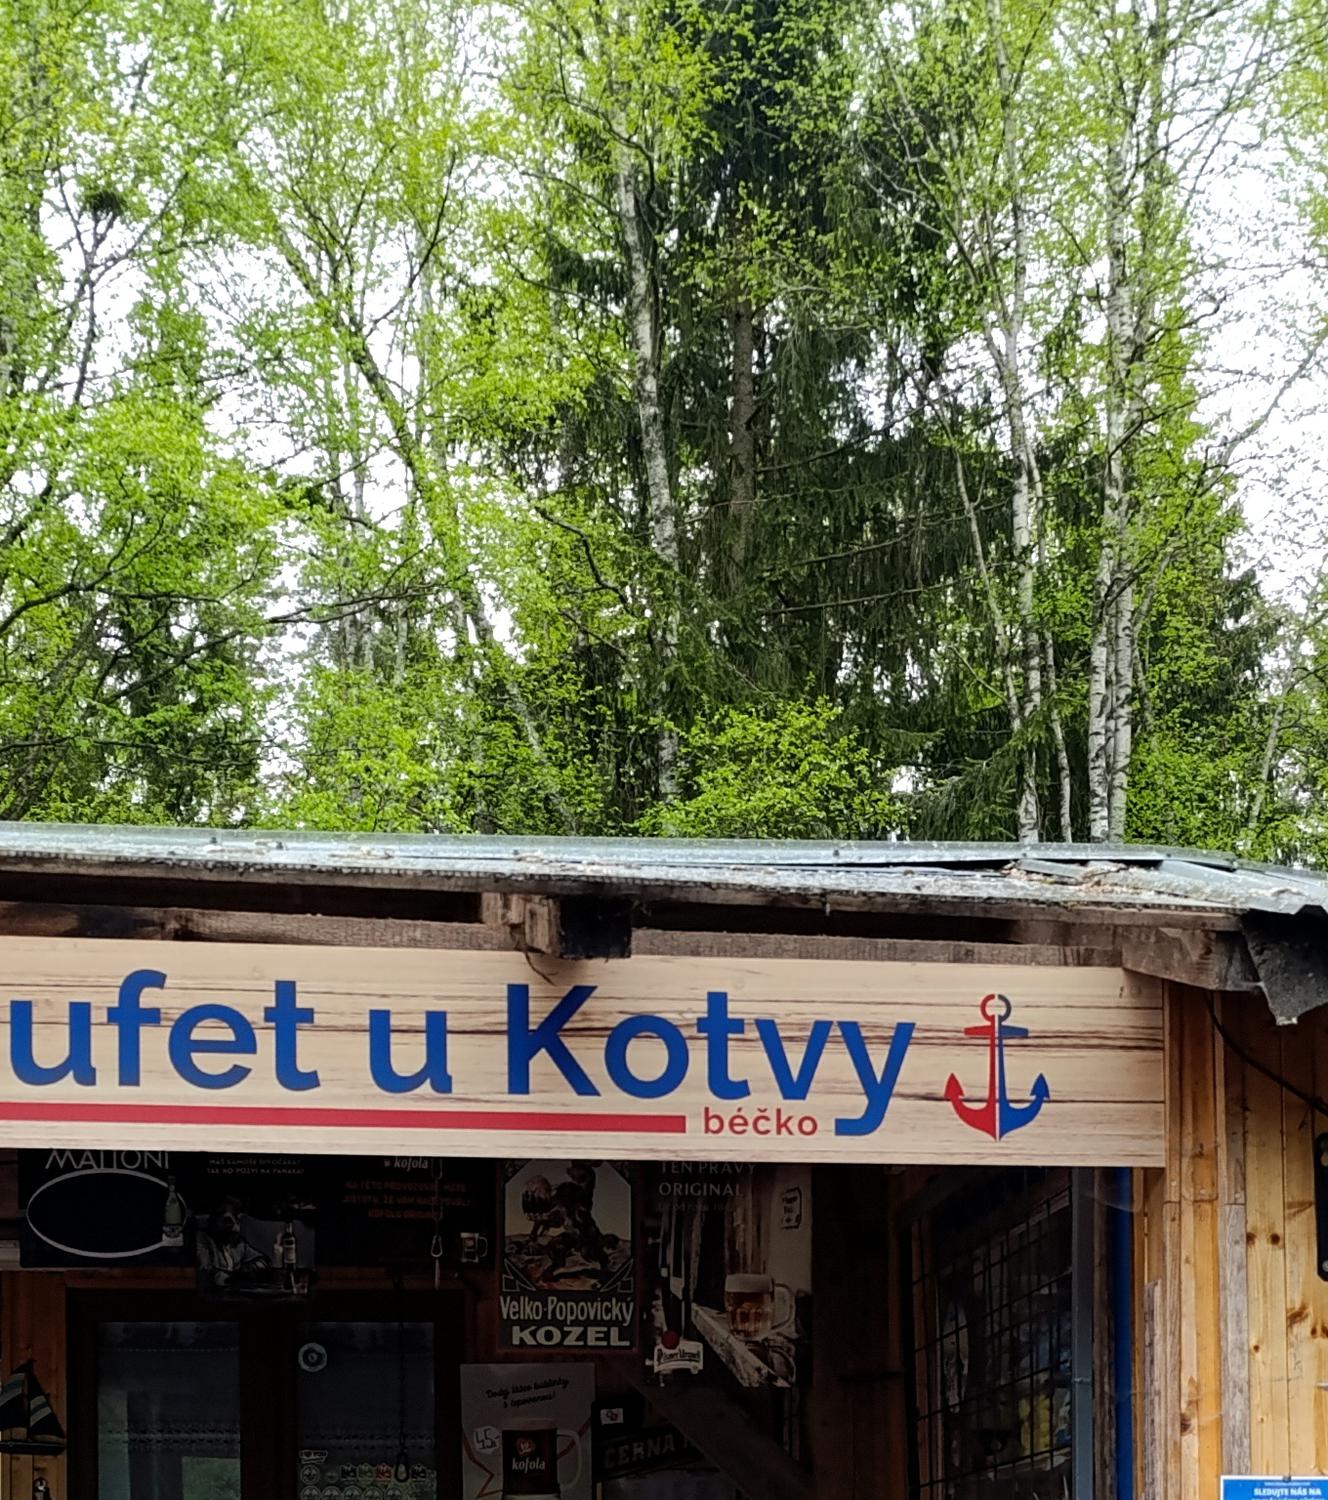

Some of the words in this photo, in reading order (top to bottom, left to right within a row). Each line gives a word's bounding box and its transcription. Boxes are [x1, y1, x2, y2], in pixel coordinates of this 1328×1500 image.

[368, 1009, 452, 1094] u
[506, 983, 917, 1136] Kotvy
[703, 1107, 818, 1136] béčko
[512, 1325, 632, 1347] KOZEL
[512, 1456, 546, 1474] kofola
[1253, 1487, 1290, 1497] SLEDUJTE
[1309, 1487, 1322, 1496] NA
